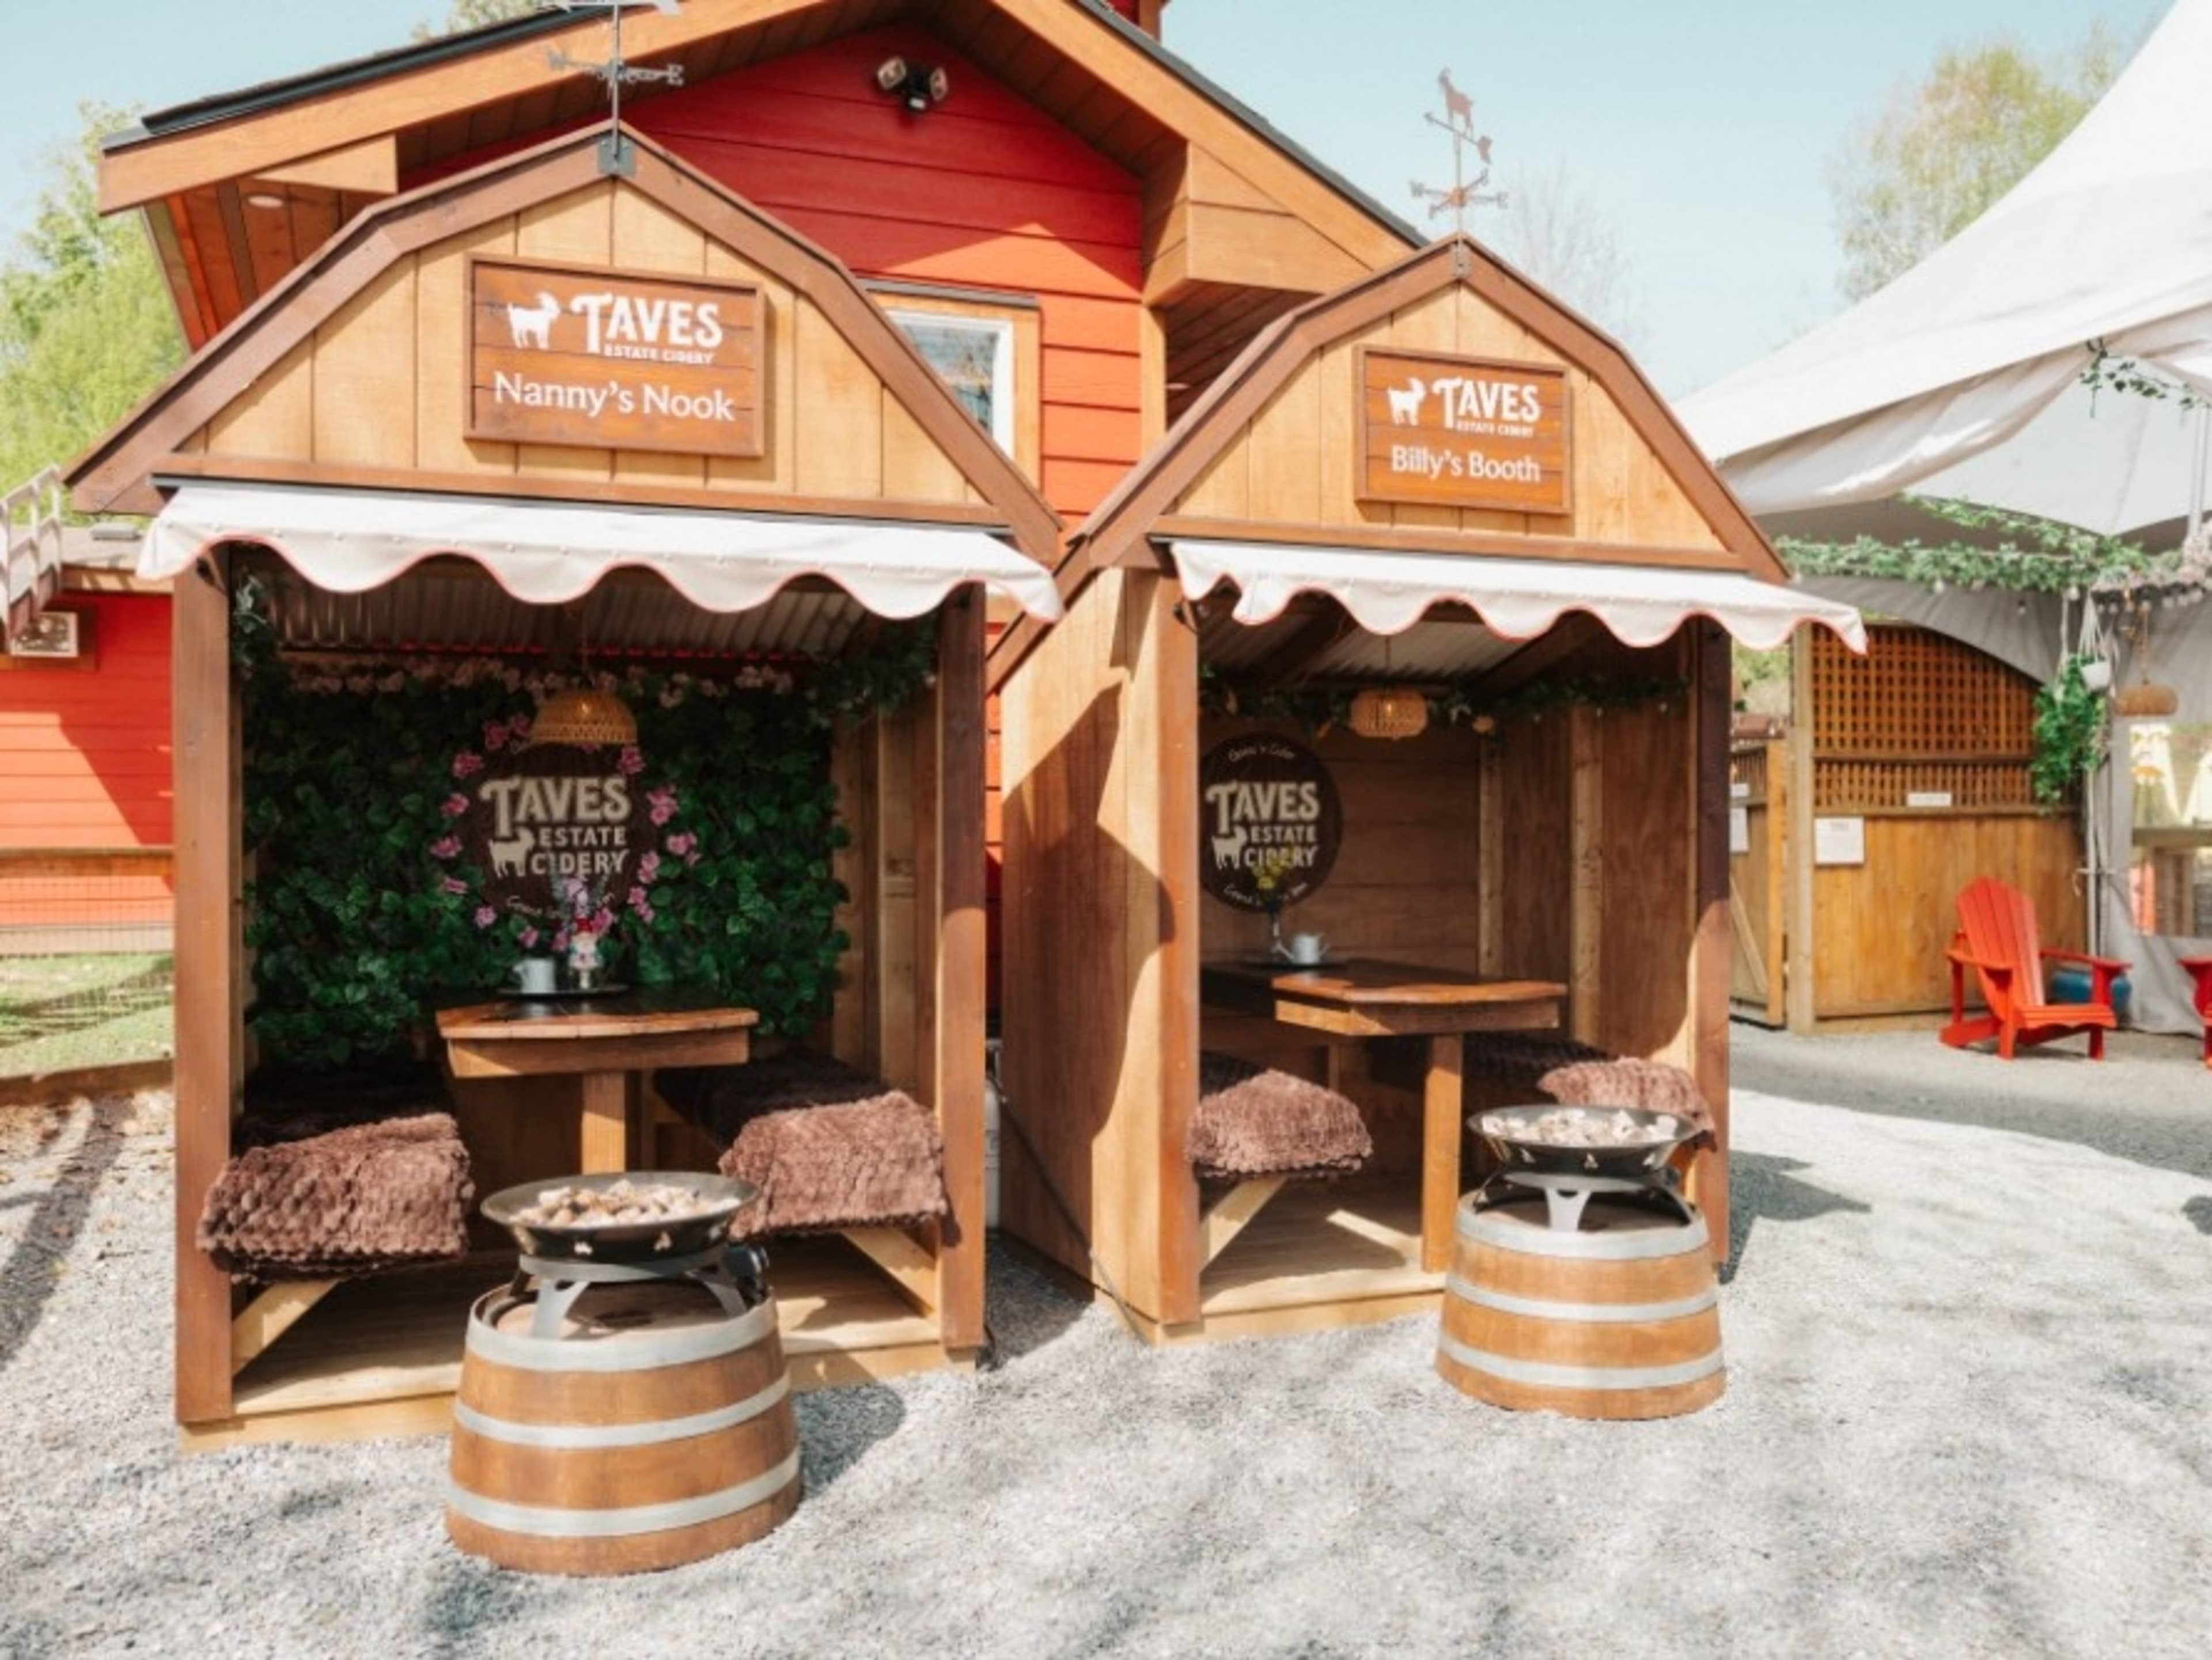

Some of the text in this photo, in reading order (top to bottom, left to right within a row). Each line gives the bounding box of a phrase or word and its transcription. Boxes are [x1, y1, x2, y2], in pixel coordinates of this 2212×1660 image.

[570, 292, 723, 354] TAVES
[494, 370, 736, 421] Nanny's Nook
[1432, 376, 1541, 429] TAVES
[1391, 444, 1541, 483] Billy's Booth
[478, 774, 631, 837] TAVES
[1206, 780, 1321, 835] TAVES
[538, 826, 627, 846] ESTATE
[1250, 825, 1317, 844] ESTATE
